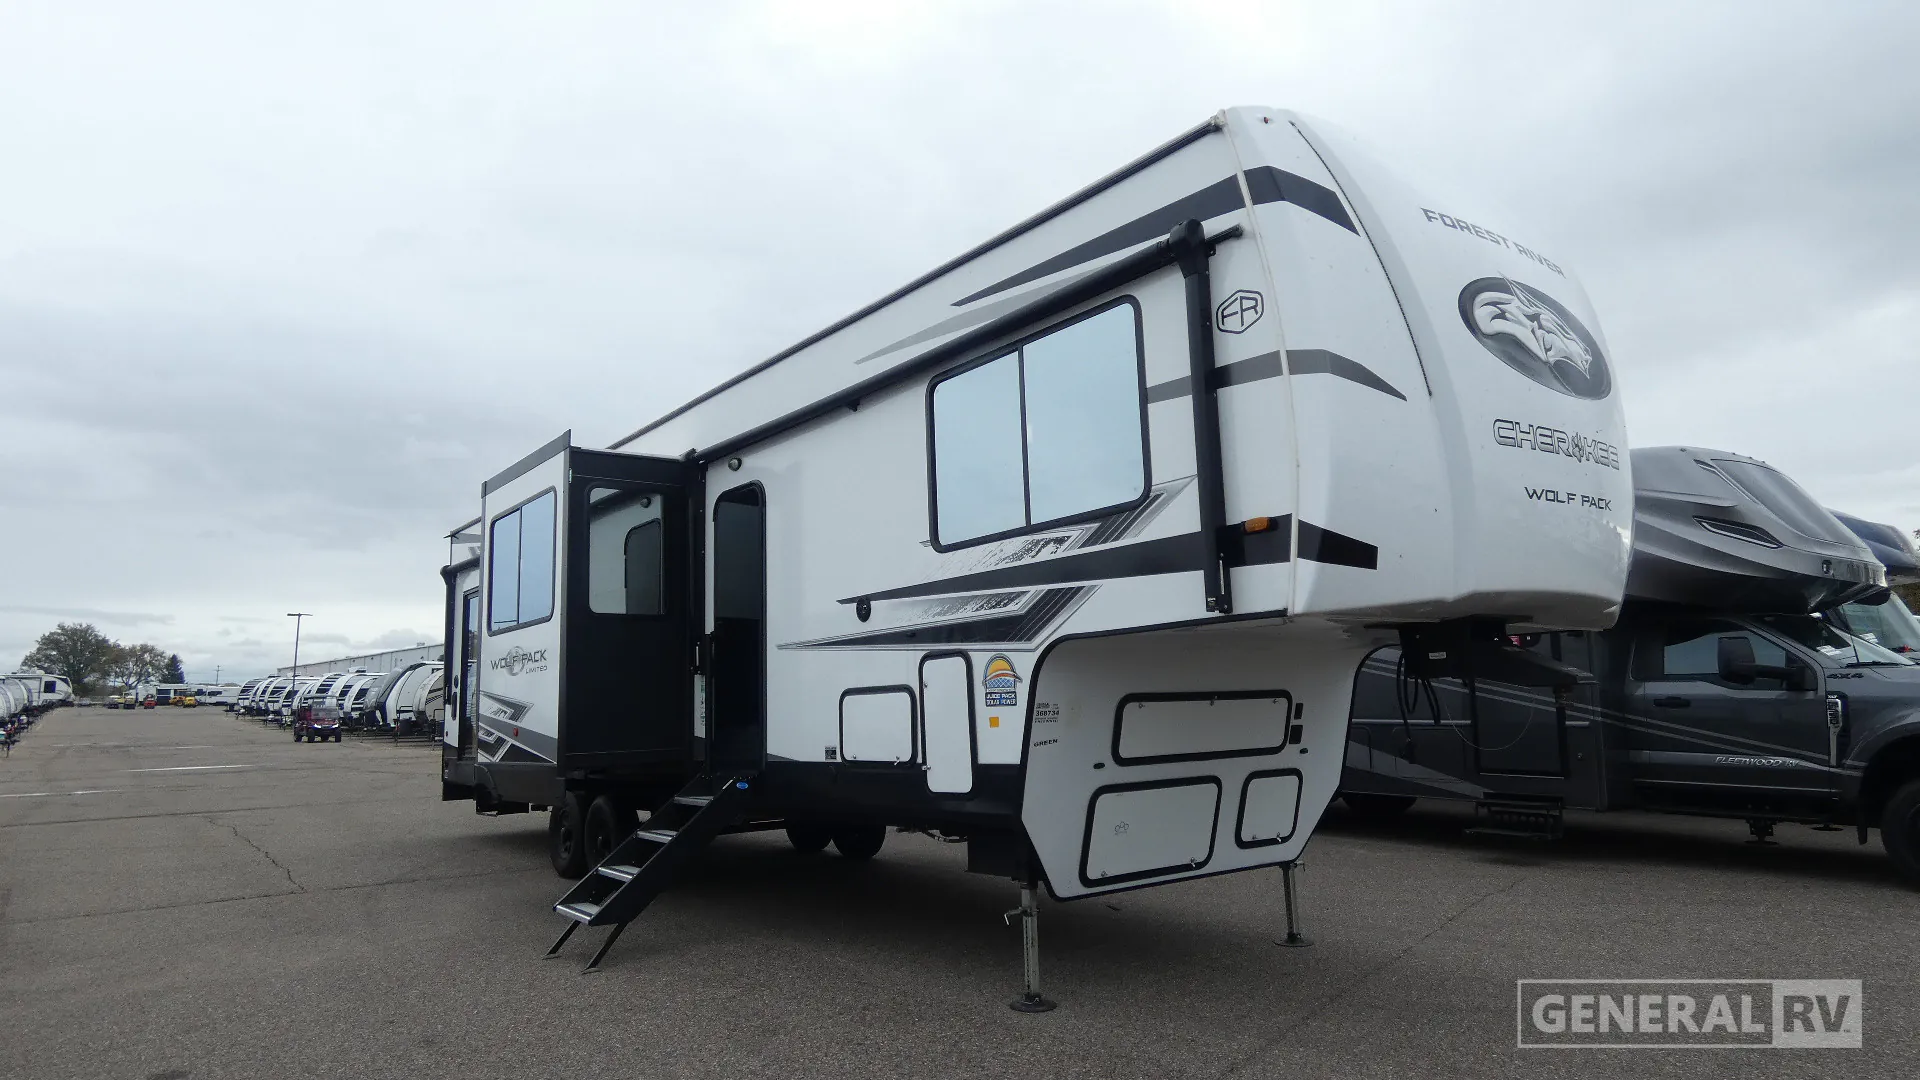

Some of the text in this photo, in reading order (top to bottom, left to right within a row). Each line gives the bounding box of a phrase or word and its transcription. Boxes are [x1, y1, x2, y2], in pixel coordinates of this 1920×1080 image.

[1420, 207, 1567, 279] FOREST RIVER
[1493, 418, 1620, 470] CHEROKEE
[1524, 486, 1613, 511] WOLF PACK
[490, 649, 547, 671] WOLF PACK
[525, 665, 548, 675] LIMITED
[1033, 739, 1058, 748] GREEN
[1716, 756, 1782, 767] FLEETWOOD
